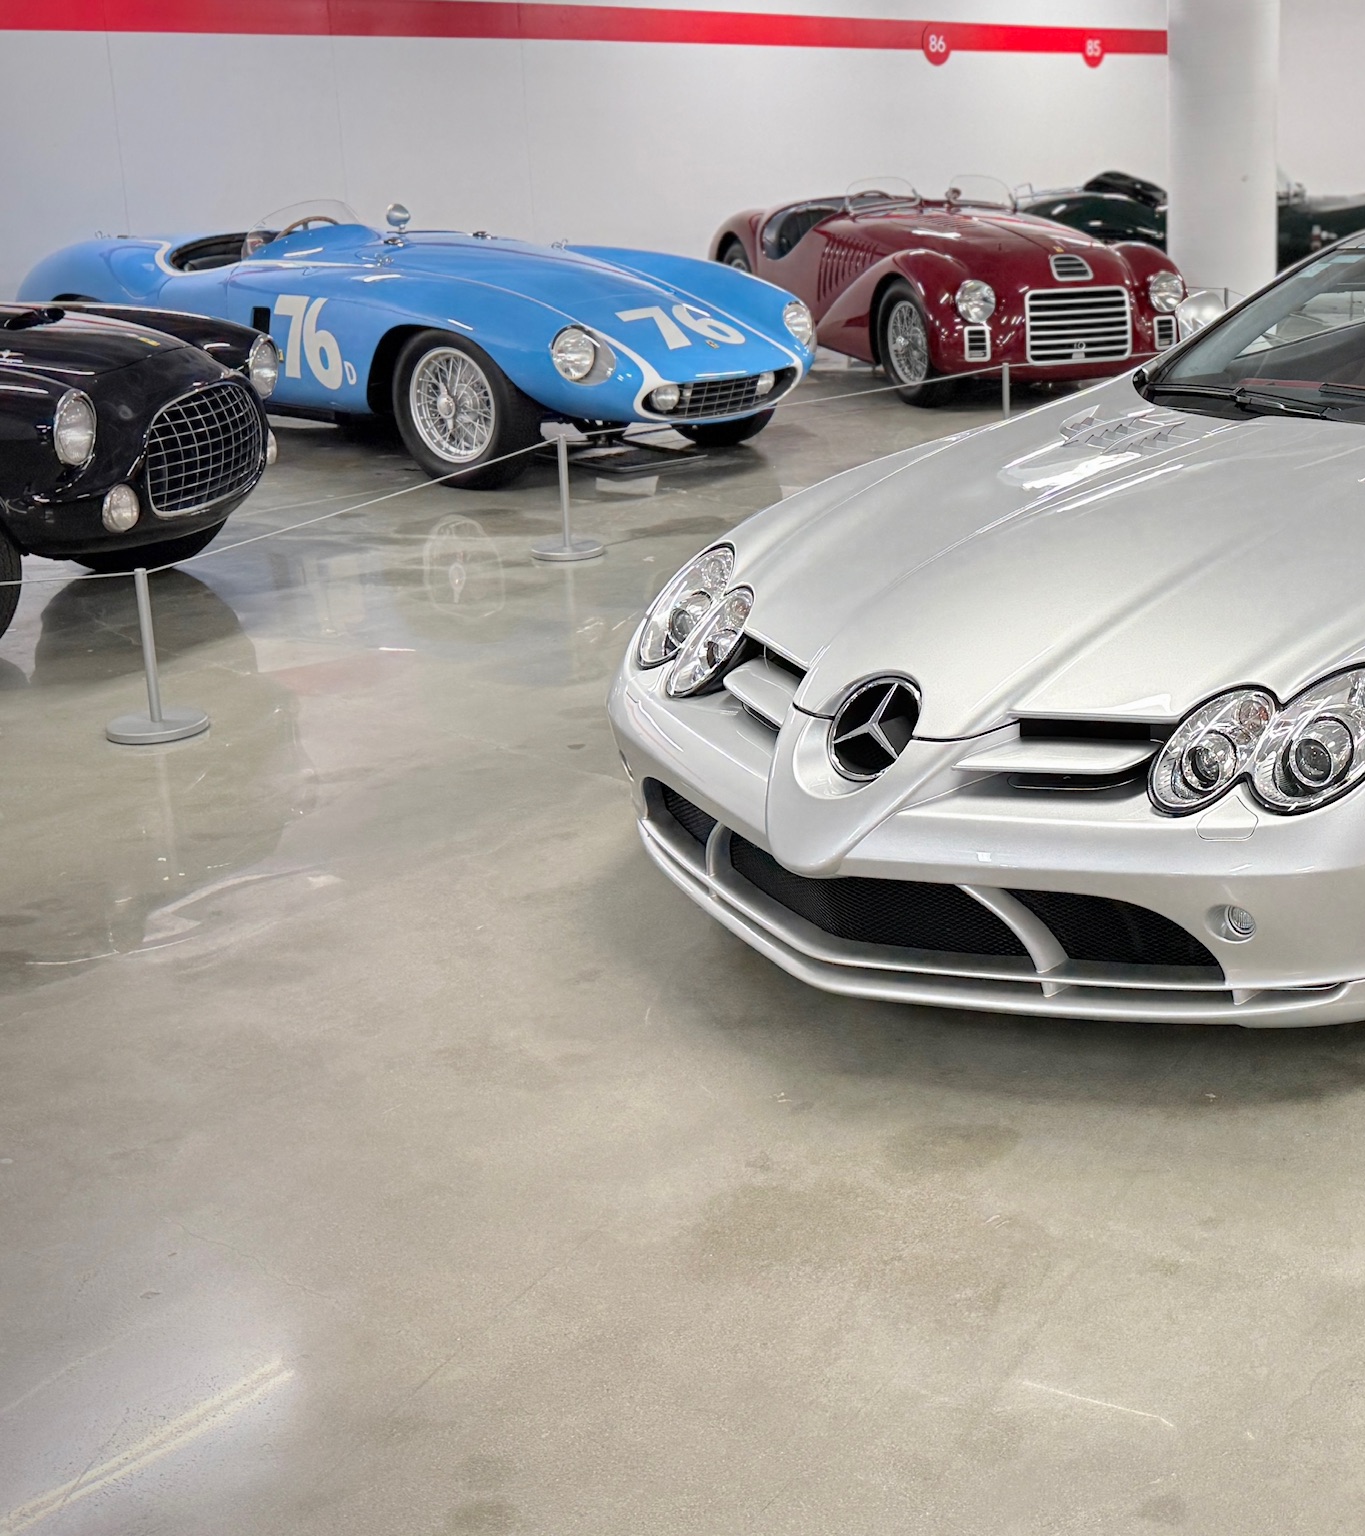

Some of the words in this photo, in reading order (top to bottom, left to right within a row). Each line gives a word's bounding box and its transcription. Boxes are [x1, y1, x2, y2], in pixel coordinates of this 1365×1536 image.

[929, 34, 946, 53] 86
[1086, 39, 1102, 57] 85
[274, 294, 343, 390] 76
[343, 361, 357, 385] D
[614, 304, 746, 350] 76
